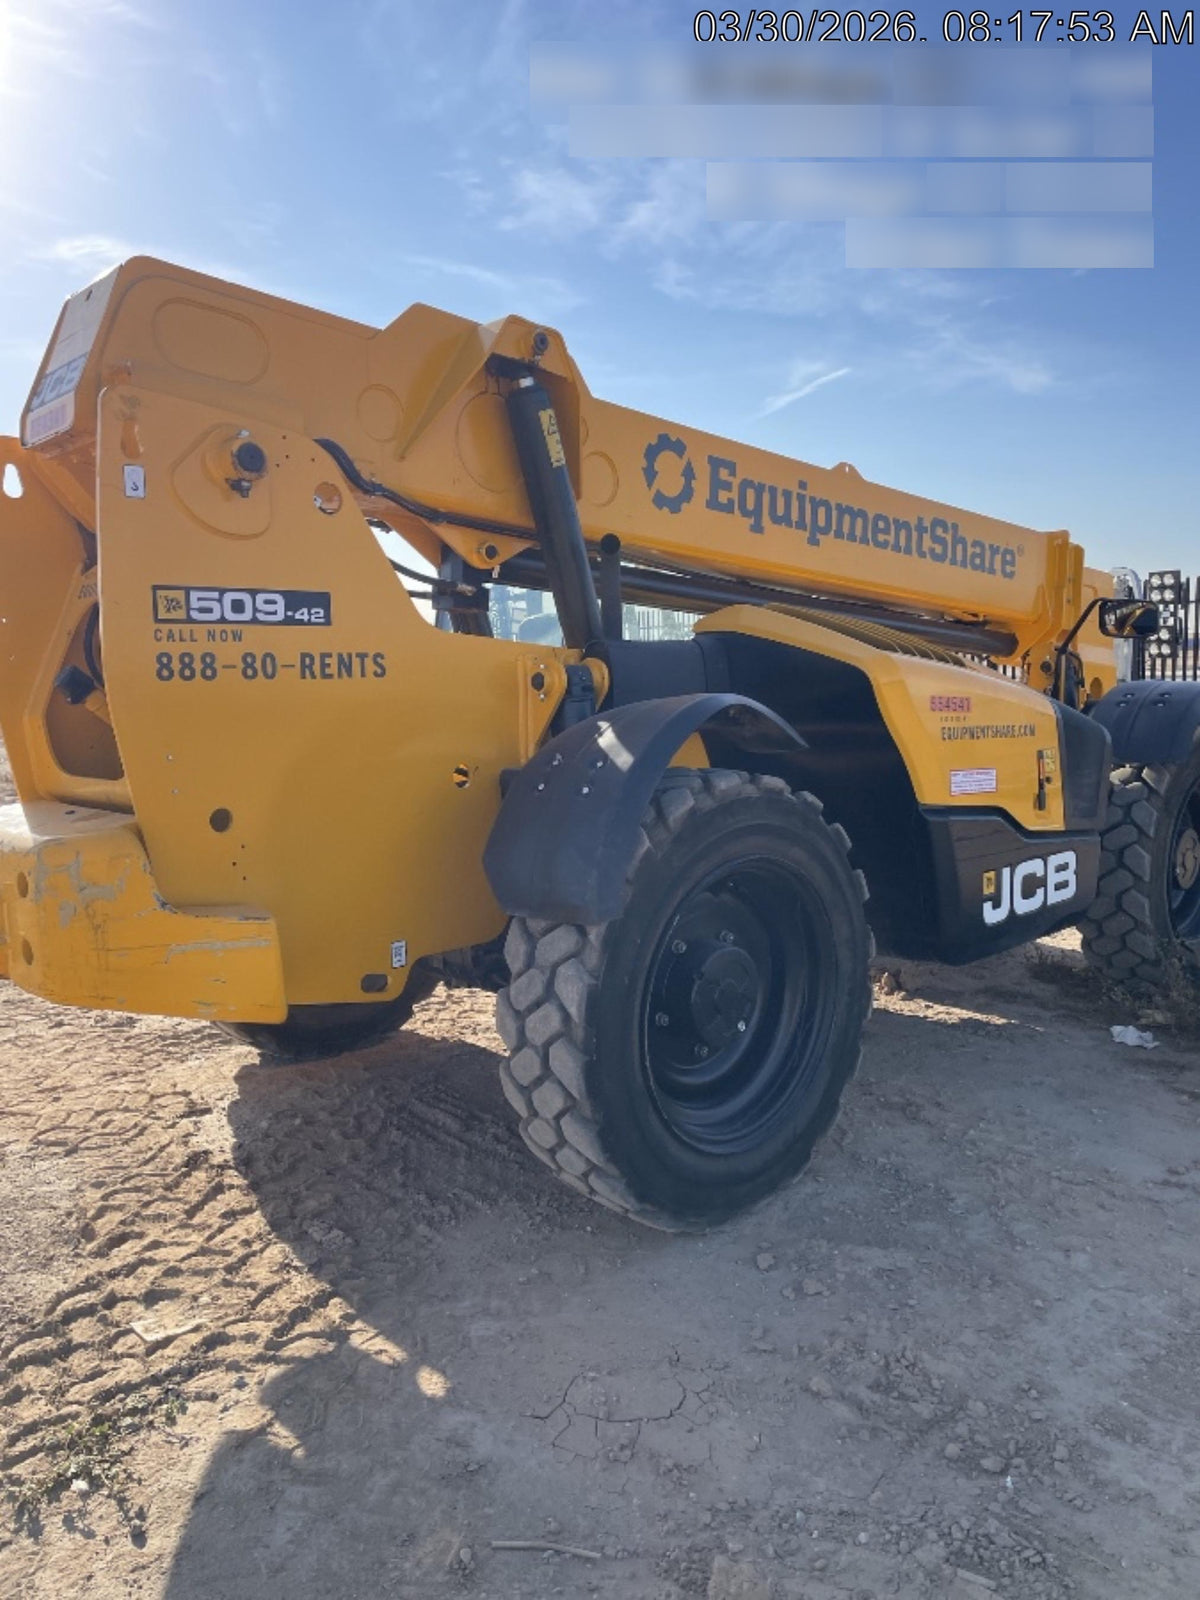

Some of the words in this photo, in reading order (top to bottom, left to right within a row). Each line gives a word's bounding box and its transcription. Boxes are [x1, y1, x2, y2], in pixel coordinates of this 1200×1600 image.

[705, 454, 1017, 580] EquipmentShare
[189, 591, 326, 623] 509-42
[153, 628, 199, 643] CALL
[206, 628, 244, 643] NOW
[155, 651, 388, 682] 888-80-RENTS
[941, 724, 1036, 742] EQUIPMENTSHARE.COM
[982, 850, 1077, 927] JCB
